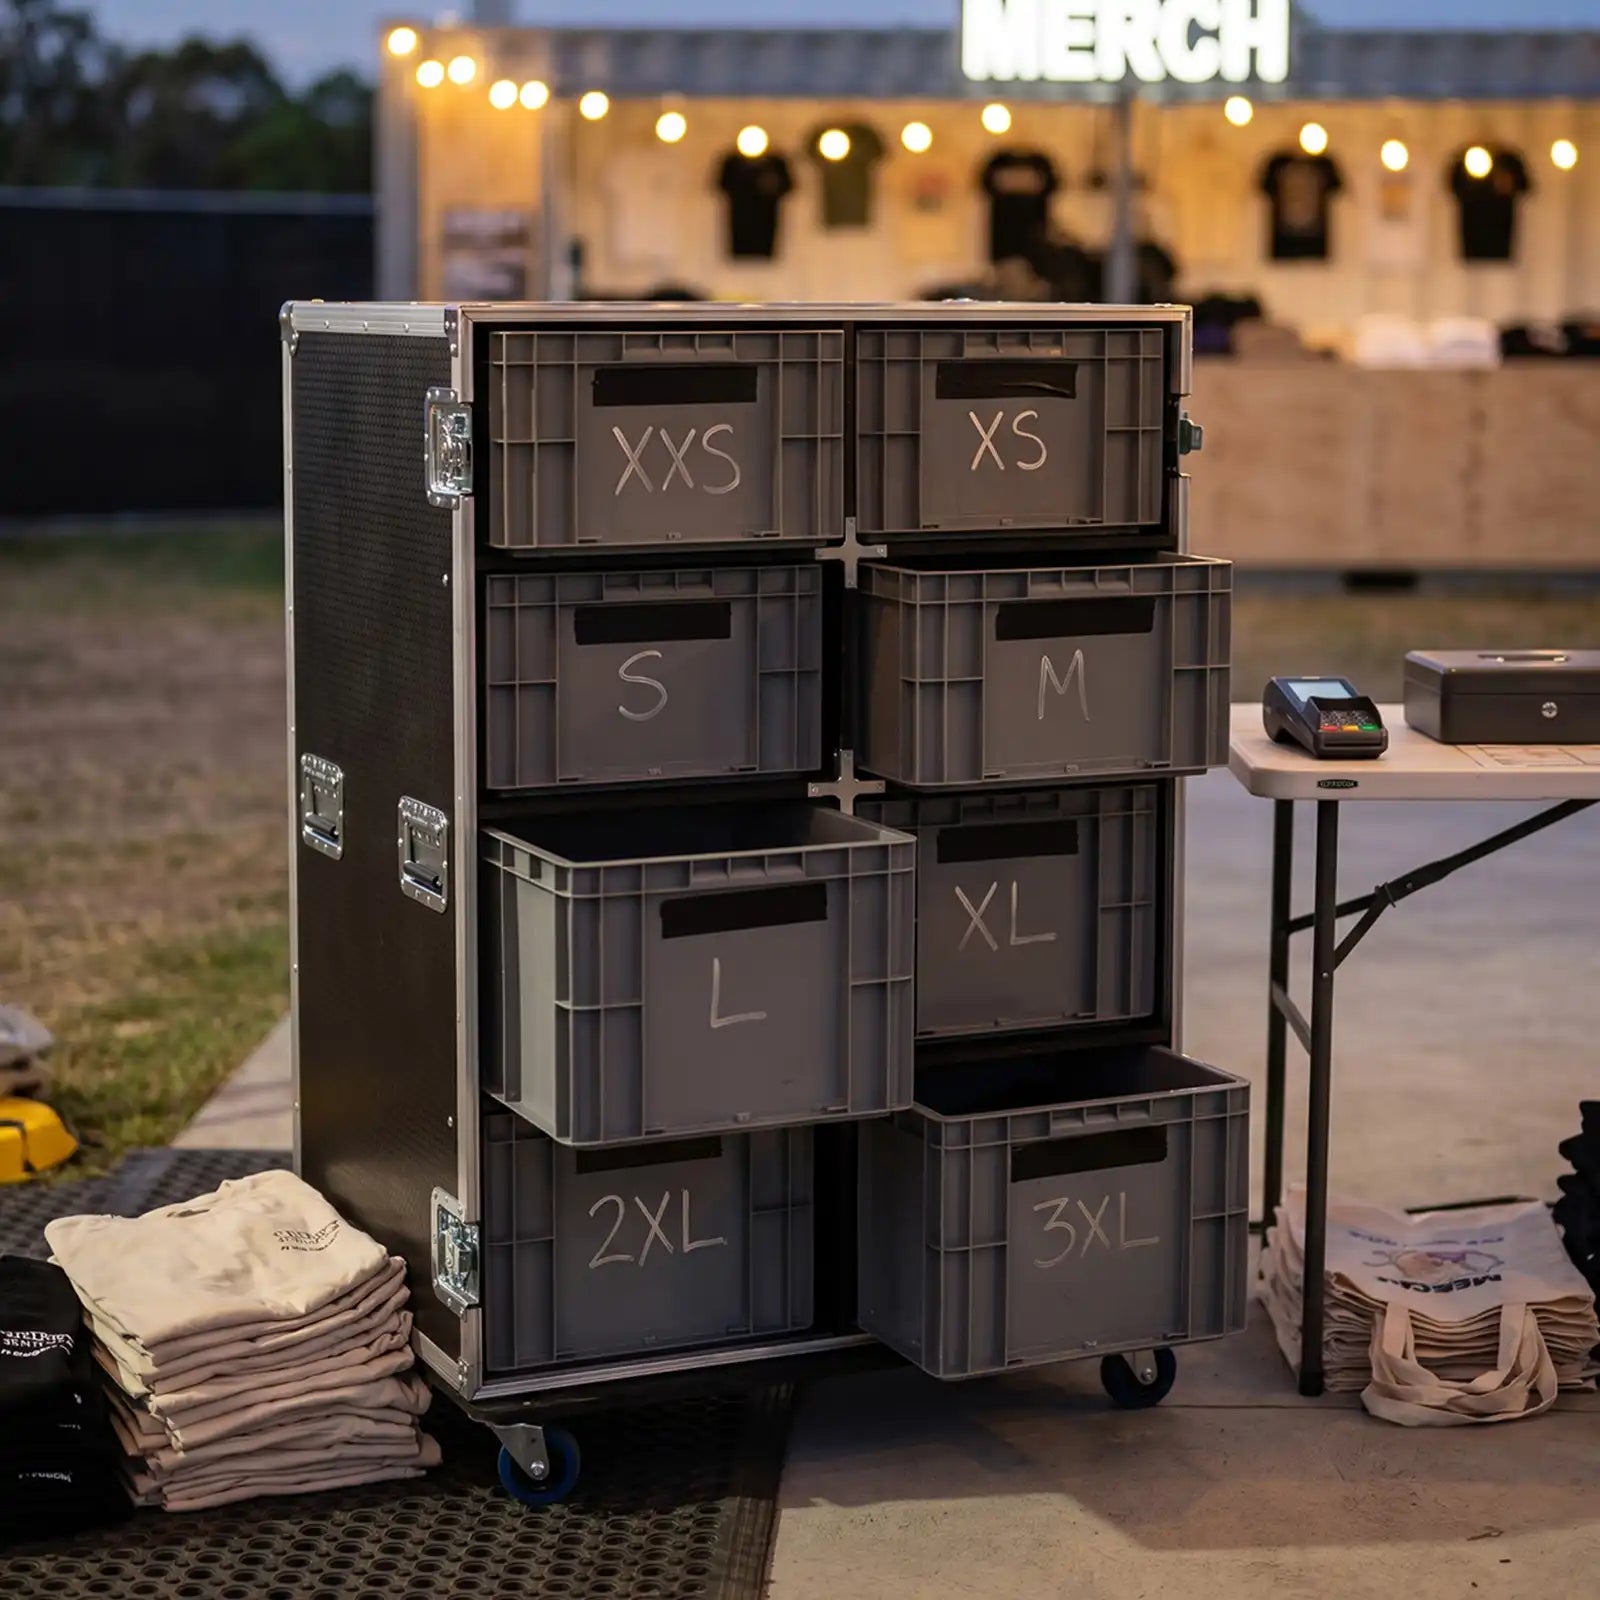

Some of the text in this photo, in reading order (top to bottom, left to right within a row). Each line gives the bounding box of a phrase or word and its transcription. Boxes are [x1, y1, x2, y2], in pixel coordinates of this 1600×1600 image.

[962, 0, 1290, 82] MERCH
[612, 424, 740, 496] XXS
[969, 410, 1047, 471] XS
[619, 650, 667, 721] S
[1038, 649, 1090, 721] M
[955, 880, 1056, 951] XL
[710, 958, 767, 1028] L
[589, 1189, 727, 1269] 2XL
[1033, 1191, 1160, 1268] 3XL
